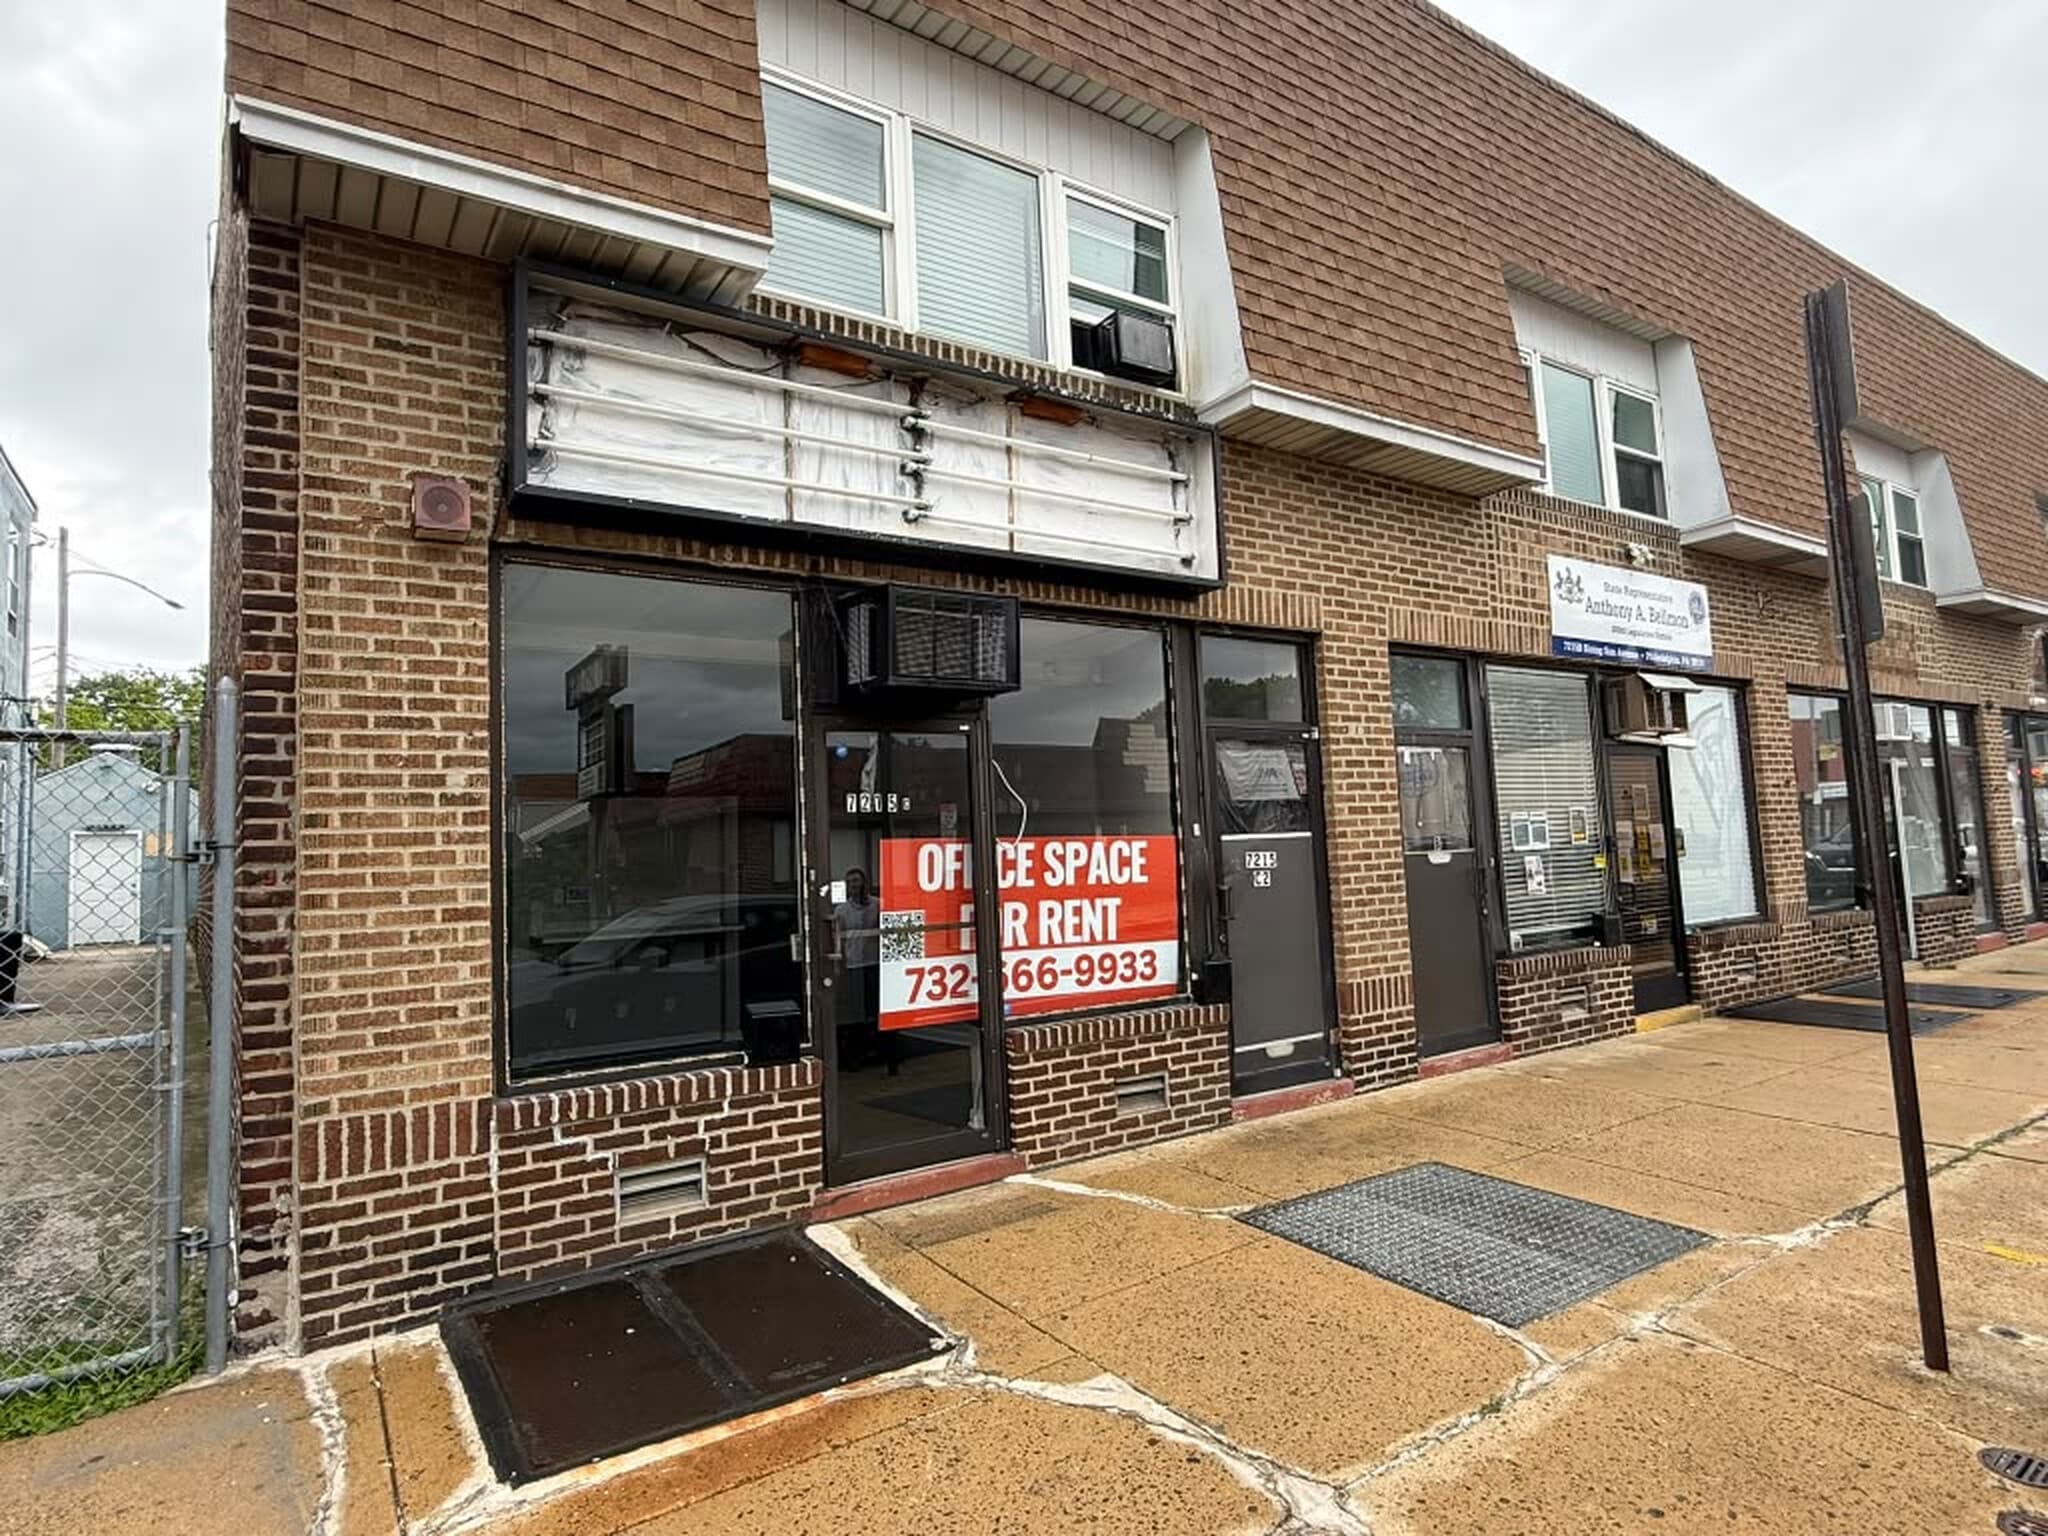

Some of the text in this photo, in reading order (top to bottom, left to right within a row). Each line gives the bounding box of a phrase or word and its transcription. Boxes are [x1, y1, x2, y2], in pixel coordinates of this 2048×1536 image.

[918, 840, 1148, 892] OFFCE SPACE
[1247, 852, 1276, 867] 7215
[960, 897, 1122, 951] FR RENT
